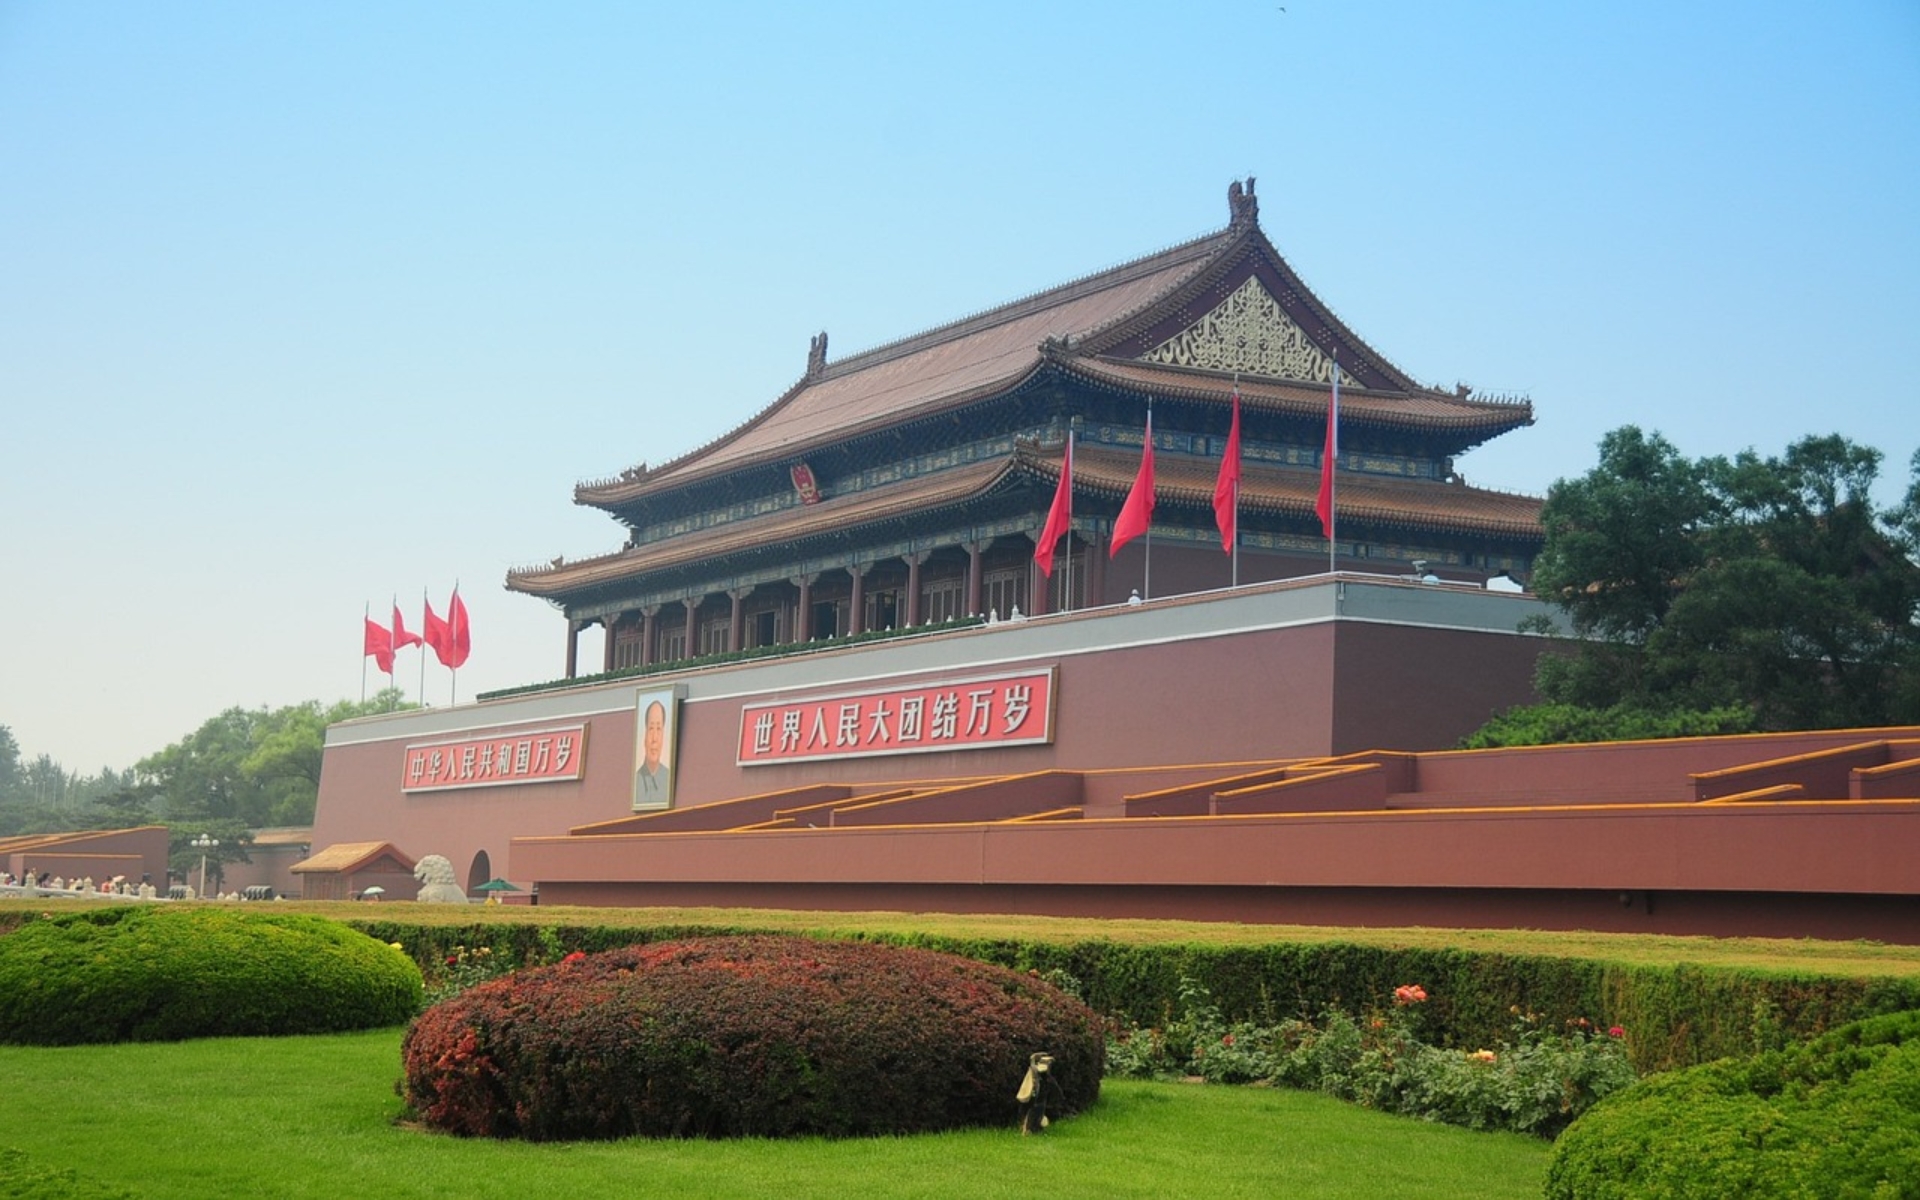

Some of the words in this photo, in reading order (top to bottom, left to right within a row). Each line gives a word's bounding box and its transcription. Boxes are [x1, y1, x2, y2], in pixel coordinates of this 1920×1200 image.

[753, 684, 1032, 754] 世界人民大团结万岁
[411, 736, 573, 783] 中华人民共和国万岁
